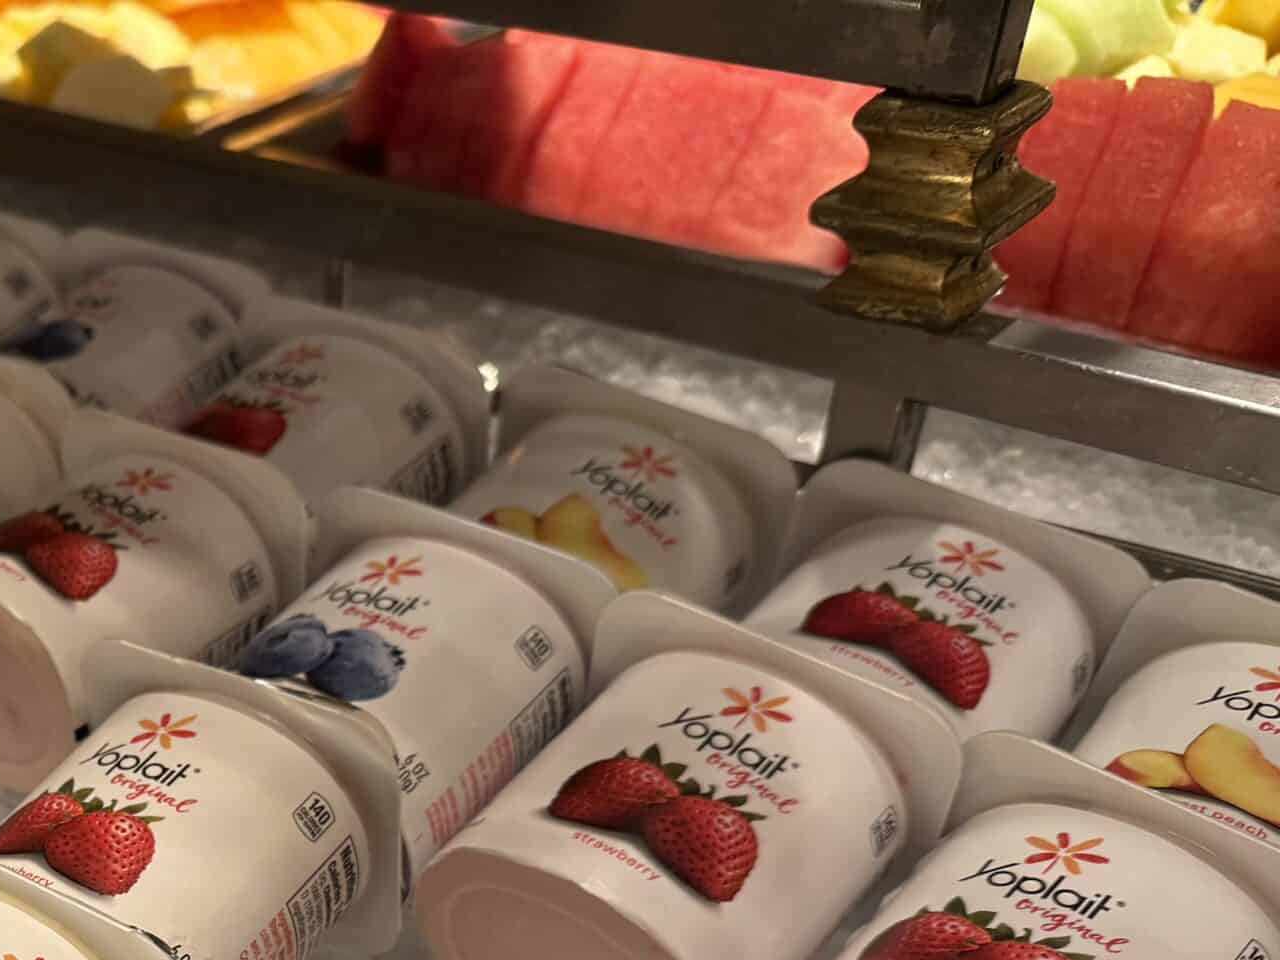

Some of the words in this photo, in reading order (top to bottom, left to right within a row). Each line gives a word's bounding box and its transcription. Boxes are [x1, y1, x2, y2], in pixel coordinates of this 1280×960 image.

[320, 580, 420, 616] Yoplait
[883, 555, 1007, 613] Yoplait
[79, 743, 194, 788] Yoplait
[656, 707, 788, 780] Yoplait
[308, 798, 331, 826] 140
[705, 752, 800, 815] original
[571, 830, 662, 881] strawberry
[958, 859, 1111, 921] Yoplait
[1015, 896, 1130, 954] original
